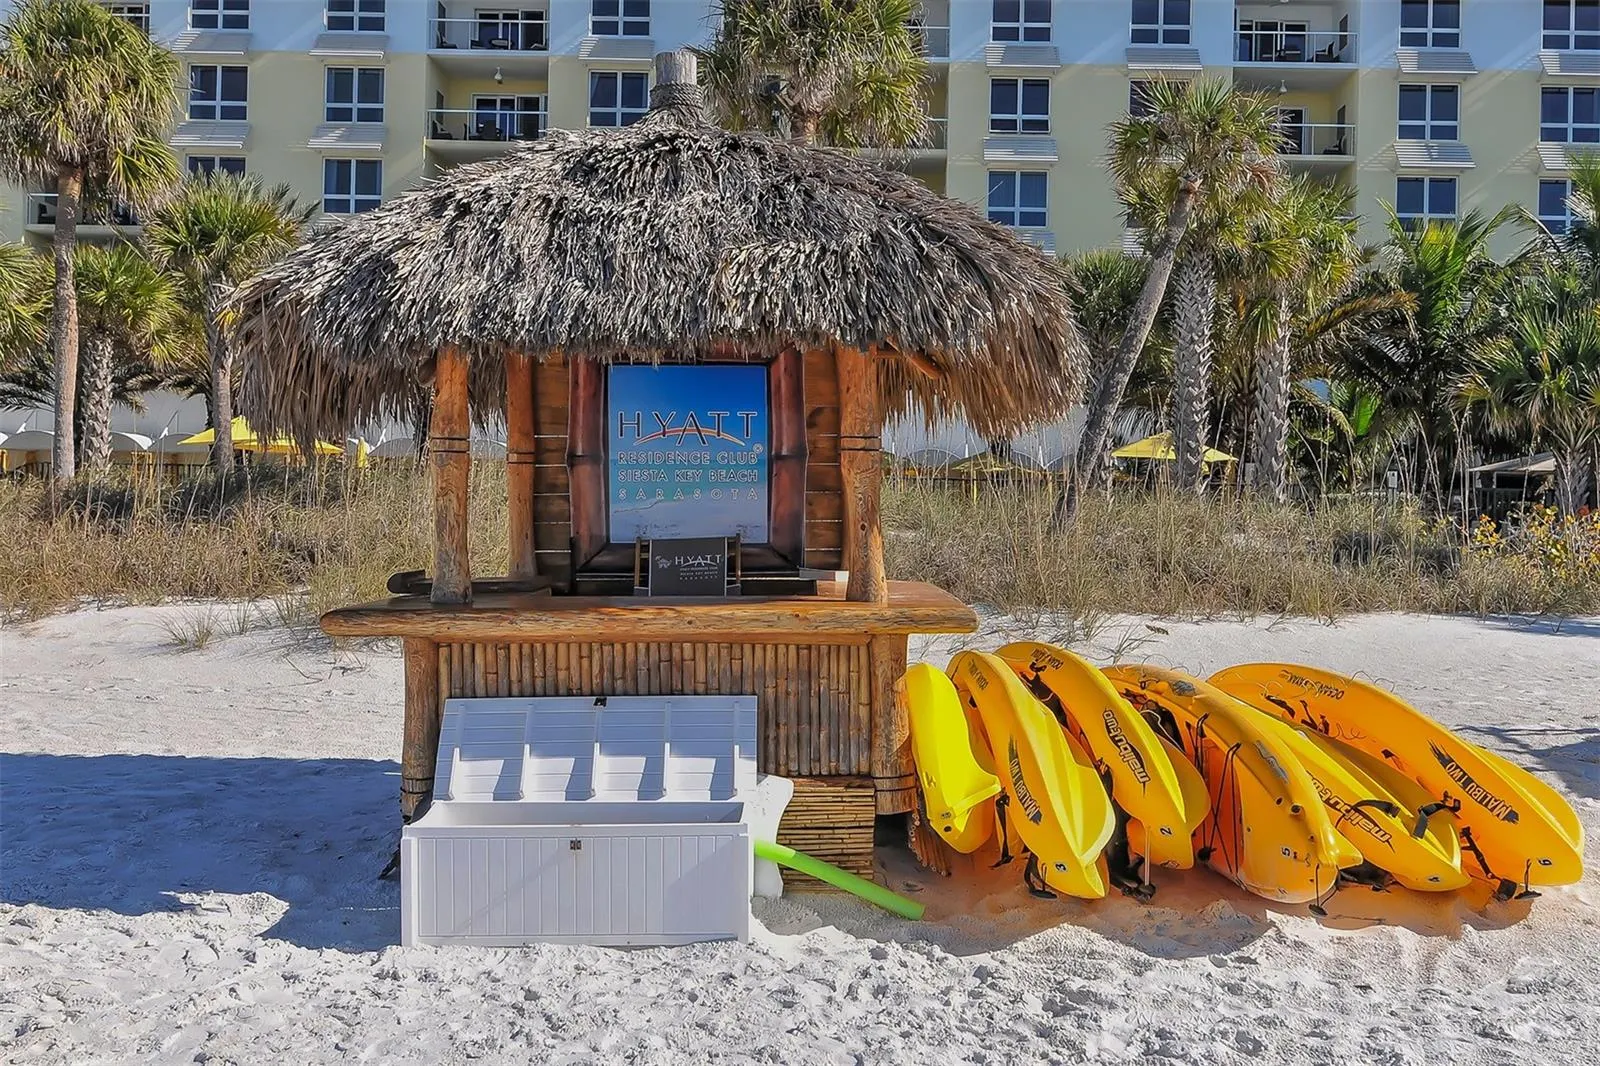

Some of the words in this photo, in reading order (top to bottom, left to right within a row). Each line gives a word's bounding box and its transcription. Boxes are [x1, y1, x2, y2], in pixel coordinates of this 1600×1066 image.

[618, 411, 758, 446] HYATT
[617, 450, 711, 465] RESIDENCE
[617, 468, 668, 482] SIESTA
[674, 468, 703, 482] KEY
[708, 468, 758, 482] BEACH
[618, 487, 758, 500] SARASOTA
[675, 554, 722, 566] HYATT
[1009, 757, 1022, 782] TWO
[1445, 761, 1469, 786] TWO
[1015, 780, 1039, 821] MALIBU
[1465, 782, 1512, 820] MALIBU
[1159, 825, 1173, 836] 2
